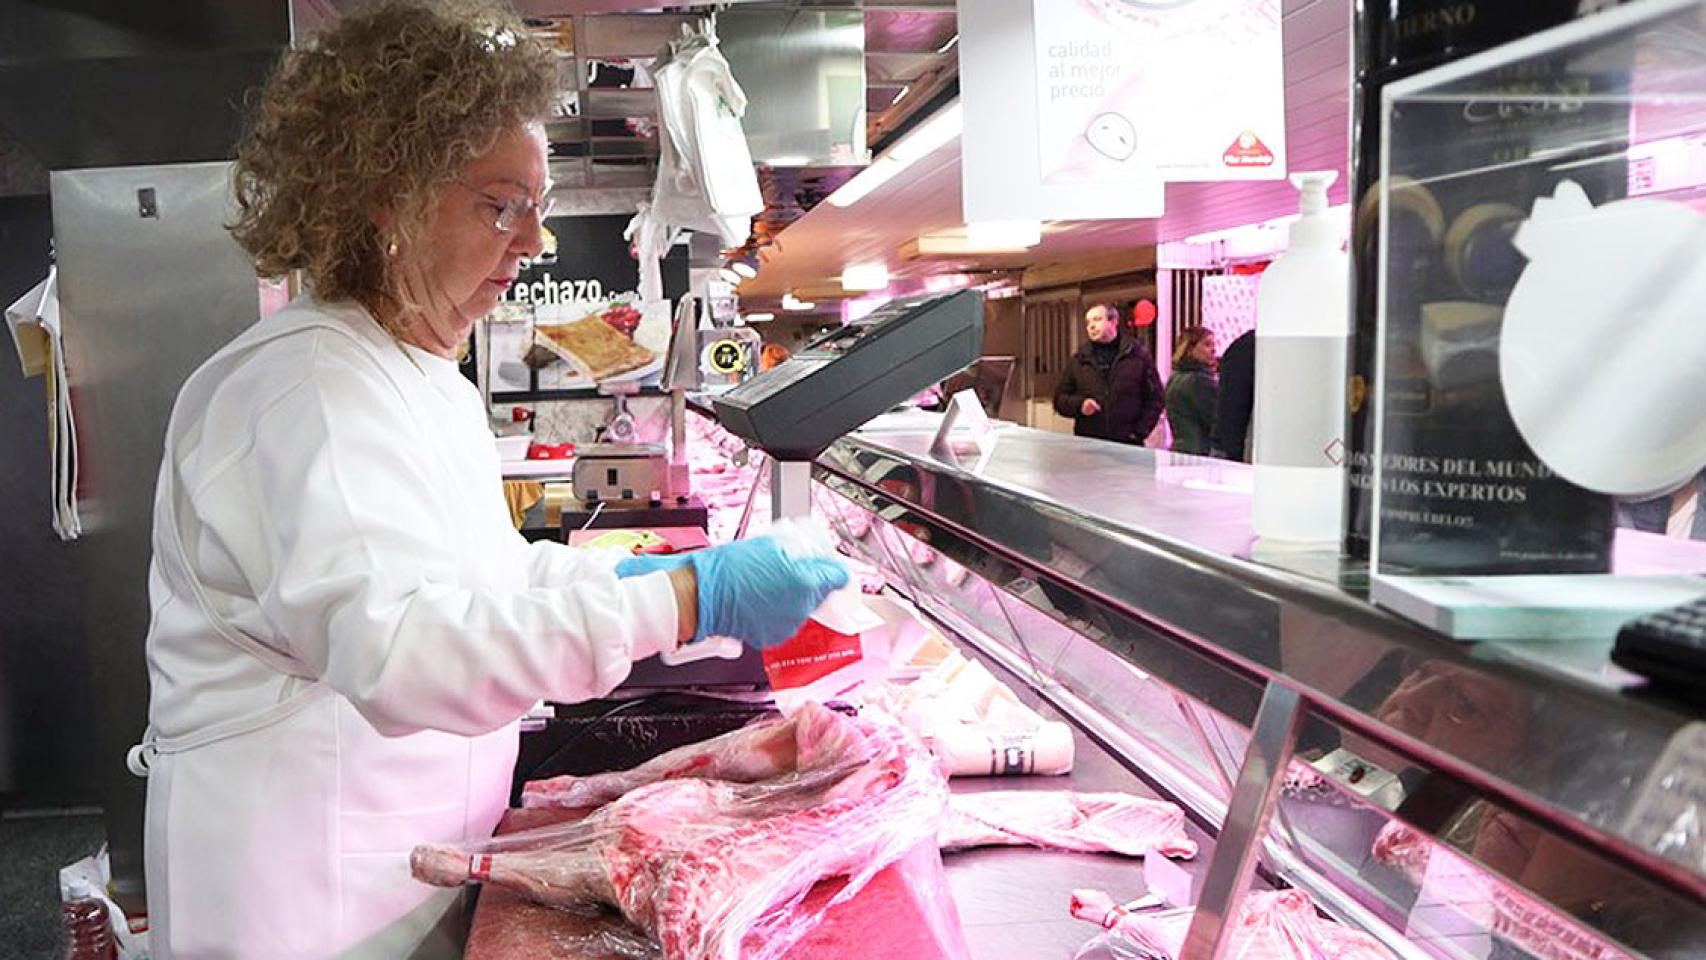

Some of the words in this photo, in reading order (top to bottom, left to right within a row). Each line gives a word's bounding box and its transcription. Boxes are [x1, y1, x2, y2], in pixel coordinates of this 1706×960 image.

[1048, 40, 1112, 58] calidad
[1049, 61, 1065, 78] al
[1071, 61, 1121, 82] mejor
[1049, 84, 1105, 103] precio
[499, 272, 601, 303] echazo
[1443, 457, 1481, 475] DEL
[1484, 460, 1553, 479] MUND
[1392, 477, 1420, 496] LOS
[1423, 479, 1527, 502] EXPERTOS
